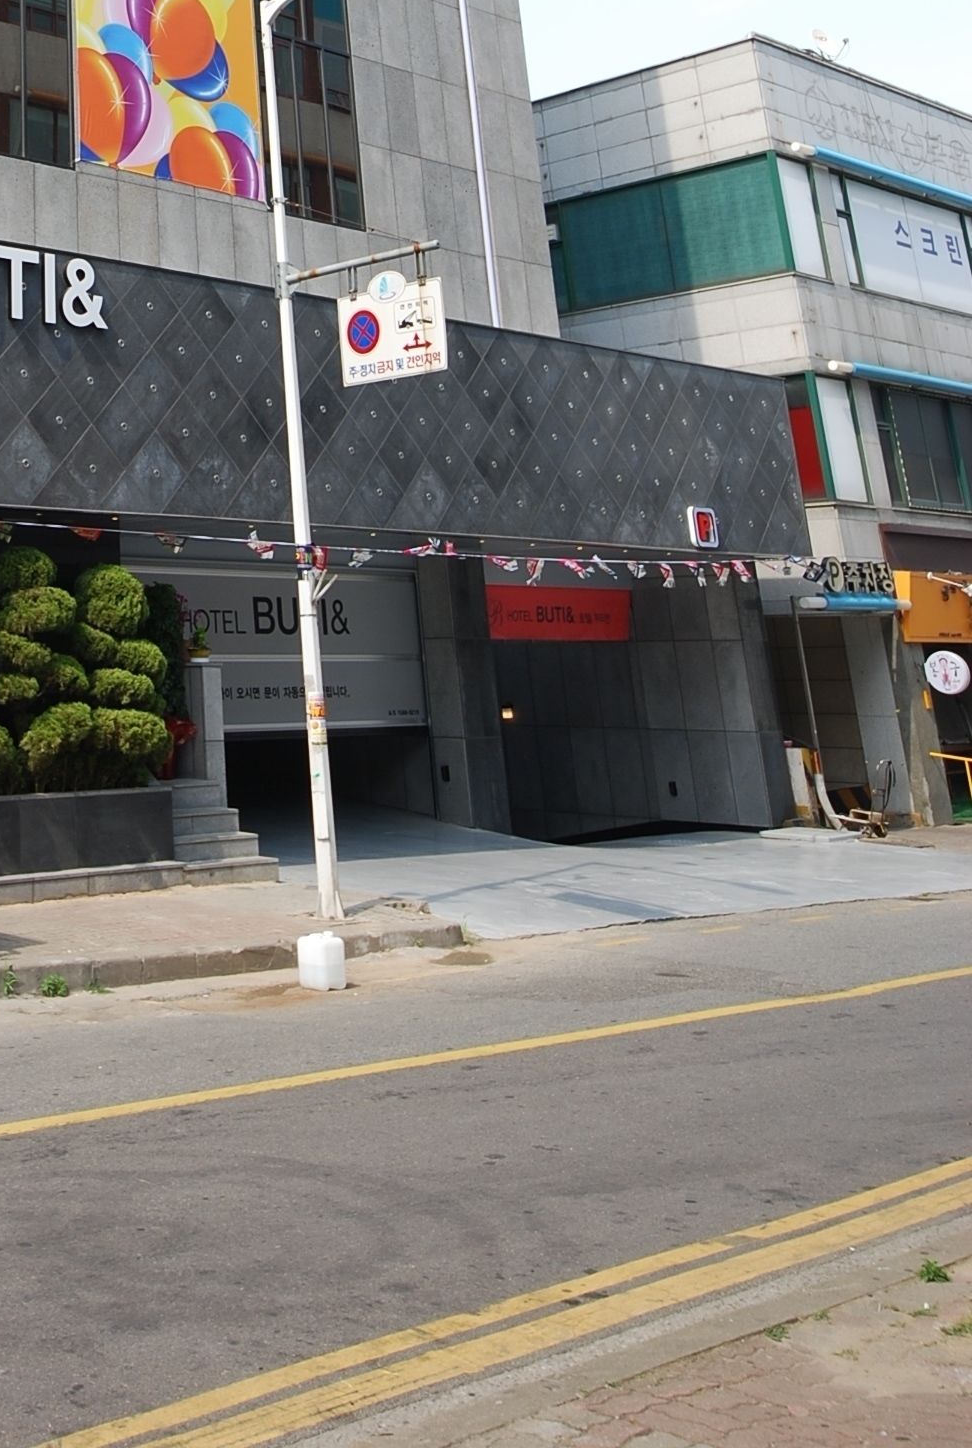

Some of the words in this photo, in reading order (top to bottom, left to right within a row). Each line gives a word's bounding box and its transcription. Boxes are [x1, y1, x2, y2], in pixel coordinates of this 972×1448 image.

[894, 220, 963, 266] 스크린
[252, 596, 350, 636] BUI&
[536, 605, 575, 624] BUTI&
